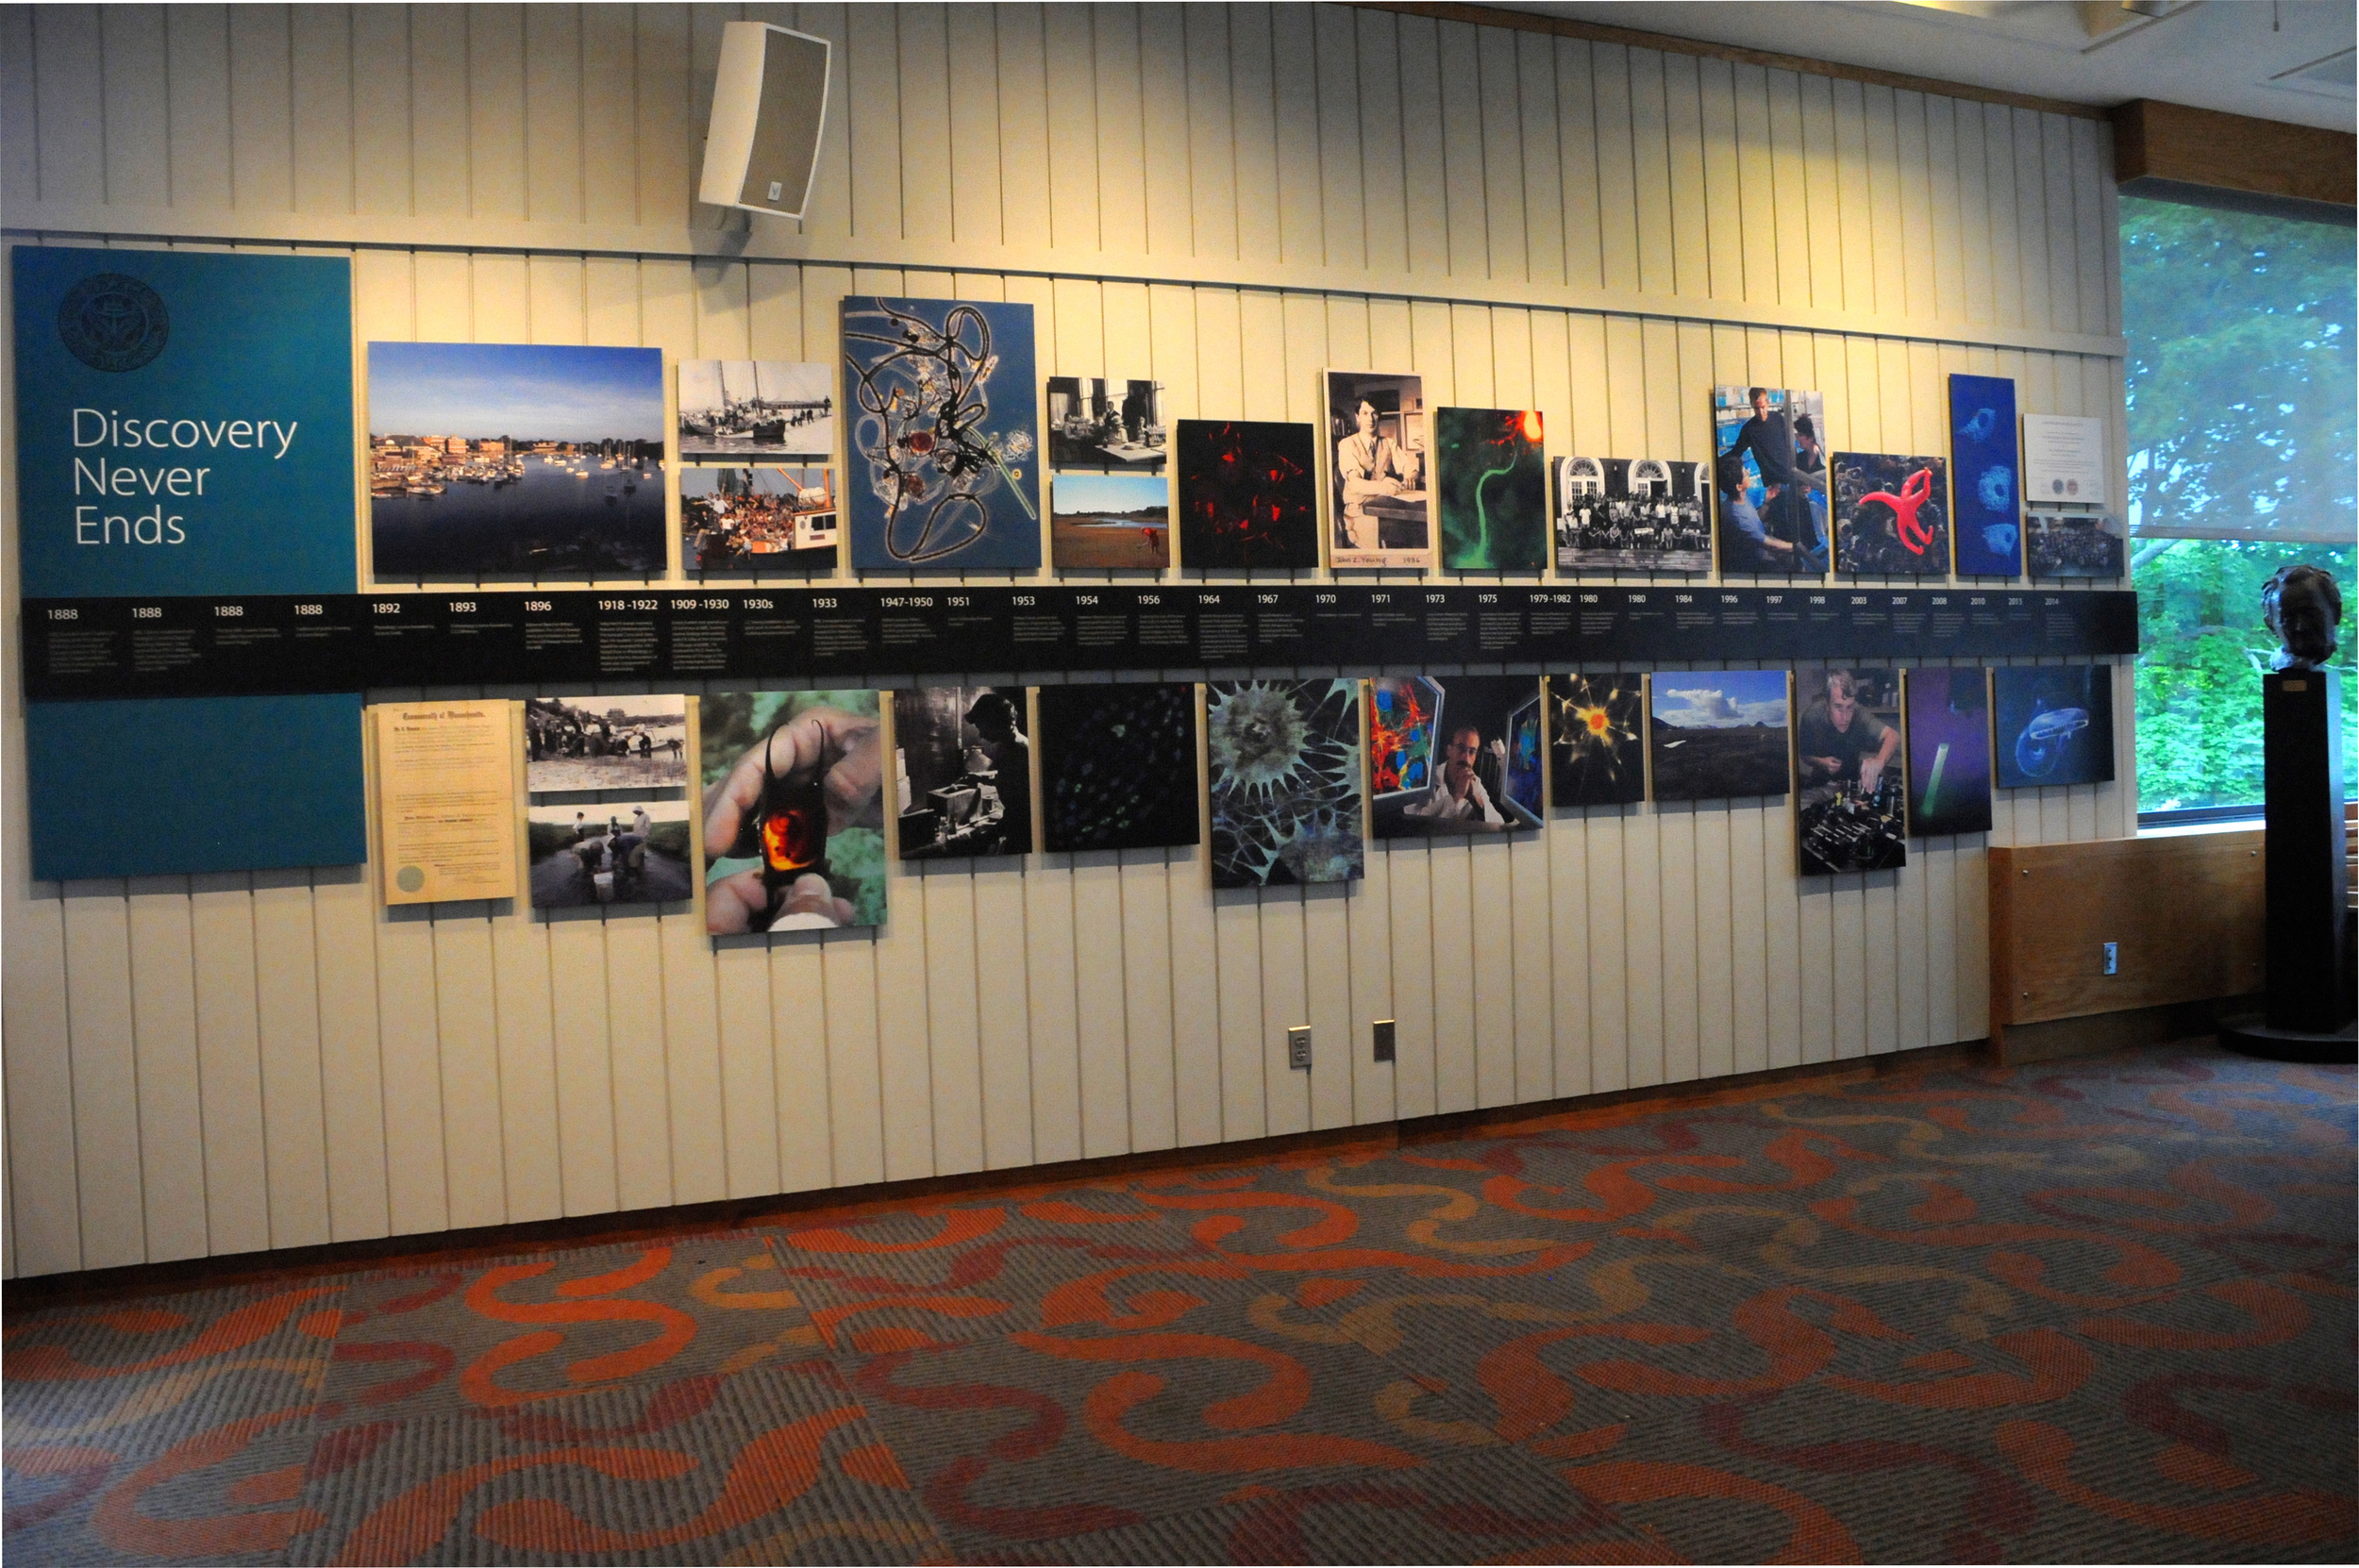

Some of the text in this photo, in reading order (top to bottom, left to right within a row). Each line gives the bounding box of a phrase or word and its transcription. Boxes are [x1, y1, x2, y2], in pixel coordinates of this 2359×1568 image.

[73, 409, 298, 459] Discovery
[75, 458, 211, 496] Never
[75, 505, 186, 545] Ends
[1361, 557, 1387, 566] Young
[743, 598, 774, 609] 1930s
[812, 597, 838, 609] 1933
[880, 596, 934, 608] 1947-1950
[946, 596, 970, 607] 1951
[1012, 595, 1036, 607] 1953
[1076, 595, 1099, 606] 1954
[1137, 594, 1161, 605] 1956
[1198, 594, 1221, 605] 1964
[1257, 593, 1279, 604] 1967
[1315, 593, 1337, 604] 1970
[1371, 593, 1391, 604] 1971
[1425, 593, 1446, 604] 1973
[1478, 593, 1498, 604] 1975
[1580, 593, 1598, 604] 1980
[1628, 594, 1647, 604] 1980
[1675, 594, 1693, 604] 1984
[1721, 594, 1739, 604] 1996
[1765, 595, 1783, 604] 1997
[1809, 595, 1826, 605] 1998
[1850, 596, 1867, 605] 2003
[1891, 596, 1908, 606] 2007
[1932, 596, 1948, 606] 2008
[214, 605, 244, 617] 1888
[294, 604, 324, 615] 1888
[372, 602, 401, 614] 1892
[449, 601, 477, 613] 1893
[525, 600, 552, 611] 1896
[47, 609, 79, 621] 1888
[132, 607, 162, 619] 1888
